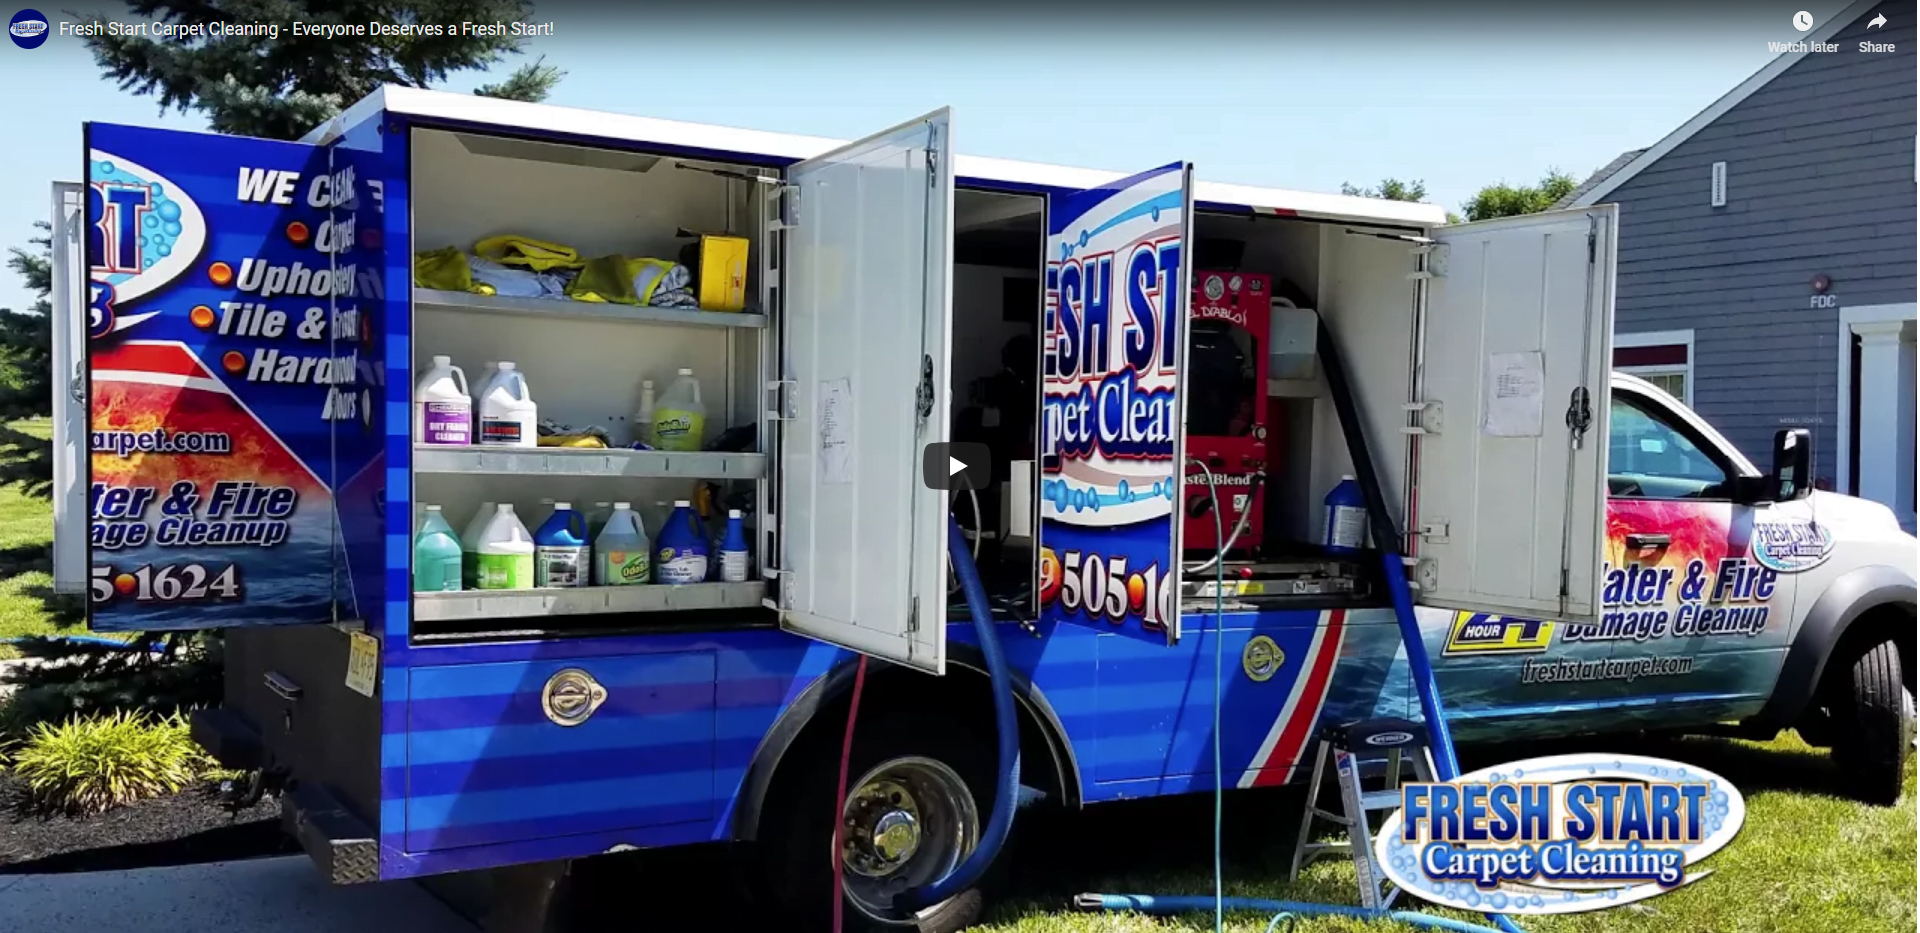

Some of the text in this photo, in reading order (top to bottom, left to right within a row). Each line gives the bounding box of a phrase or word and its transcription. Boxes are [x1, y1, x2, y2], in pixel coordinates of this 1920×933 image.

[237, 166, 300, 205] WE
[1810, 294, 1836, 308] FDC
[217, 302, 288, 338] Tile
[296, 306, 326, 340] &
[161, 480, 200, 517] &
[207, 480, 296, 518] Fire
[156, 517, 288, 547] Cleanup
[135, 564, 239, 601] 1624
[1061, 551, 1128, 618] 505
[1603, 558, 1778, 606] ater & Fire
[1464, 624, 1501, 638] HOUR
[1672, 603, 1769, 635] Cleanup
[1522, 655, 1693, 684] freshstartcarpet.com
